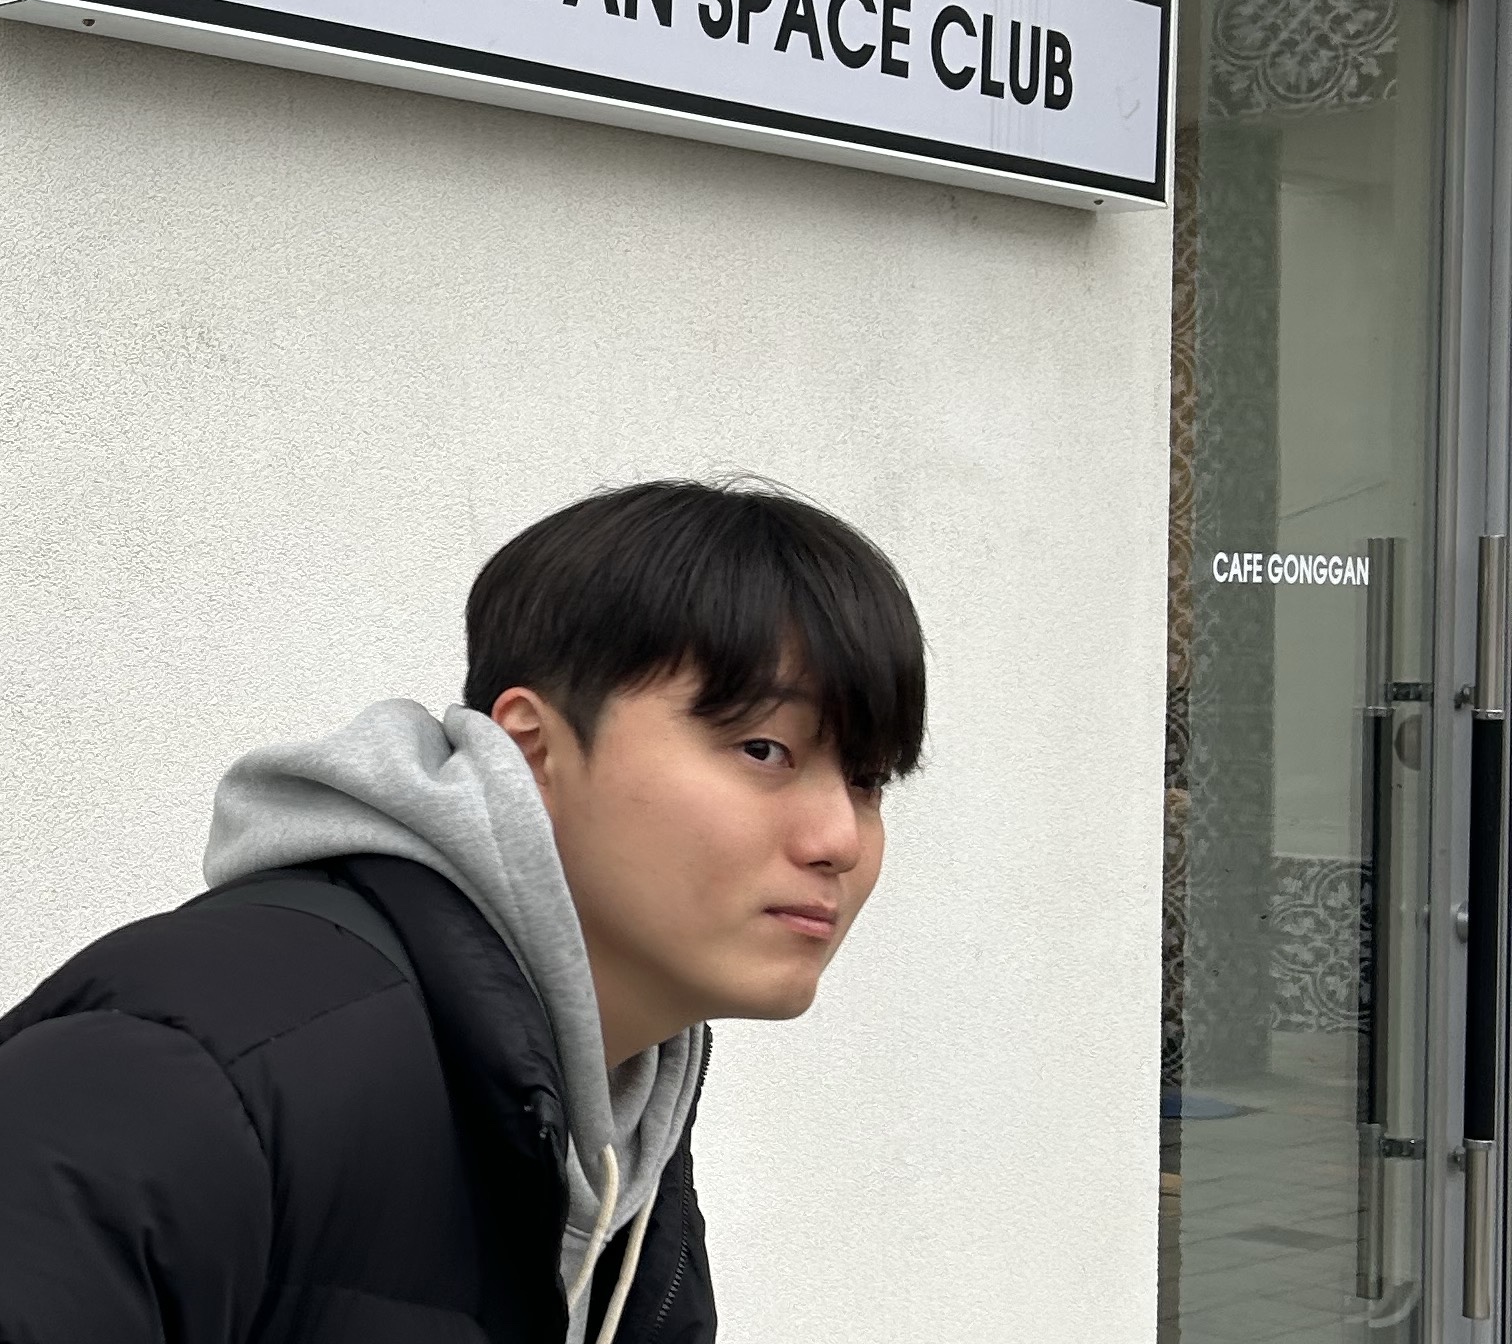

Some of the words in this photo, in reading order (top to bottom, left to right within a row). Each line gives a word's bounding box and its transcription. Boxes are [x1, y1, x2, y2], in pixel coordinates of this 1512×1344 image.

[930, 4, 1073, 112] CLUB
[1212, 551, 1263, 583] CAFE
[1267, 553, 1370, 586] GONGGAN
